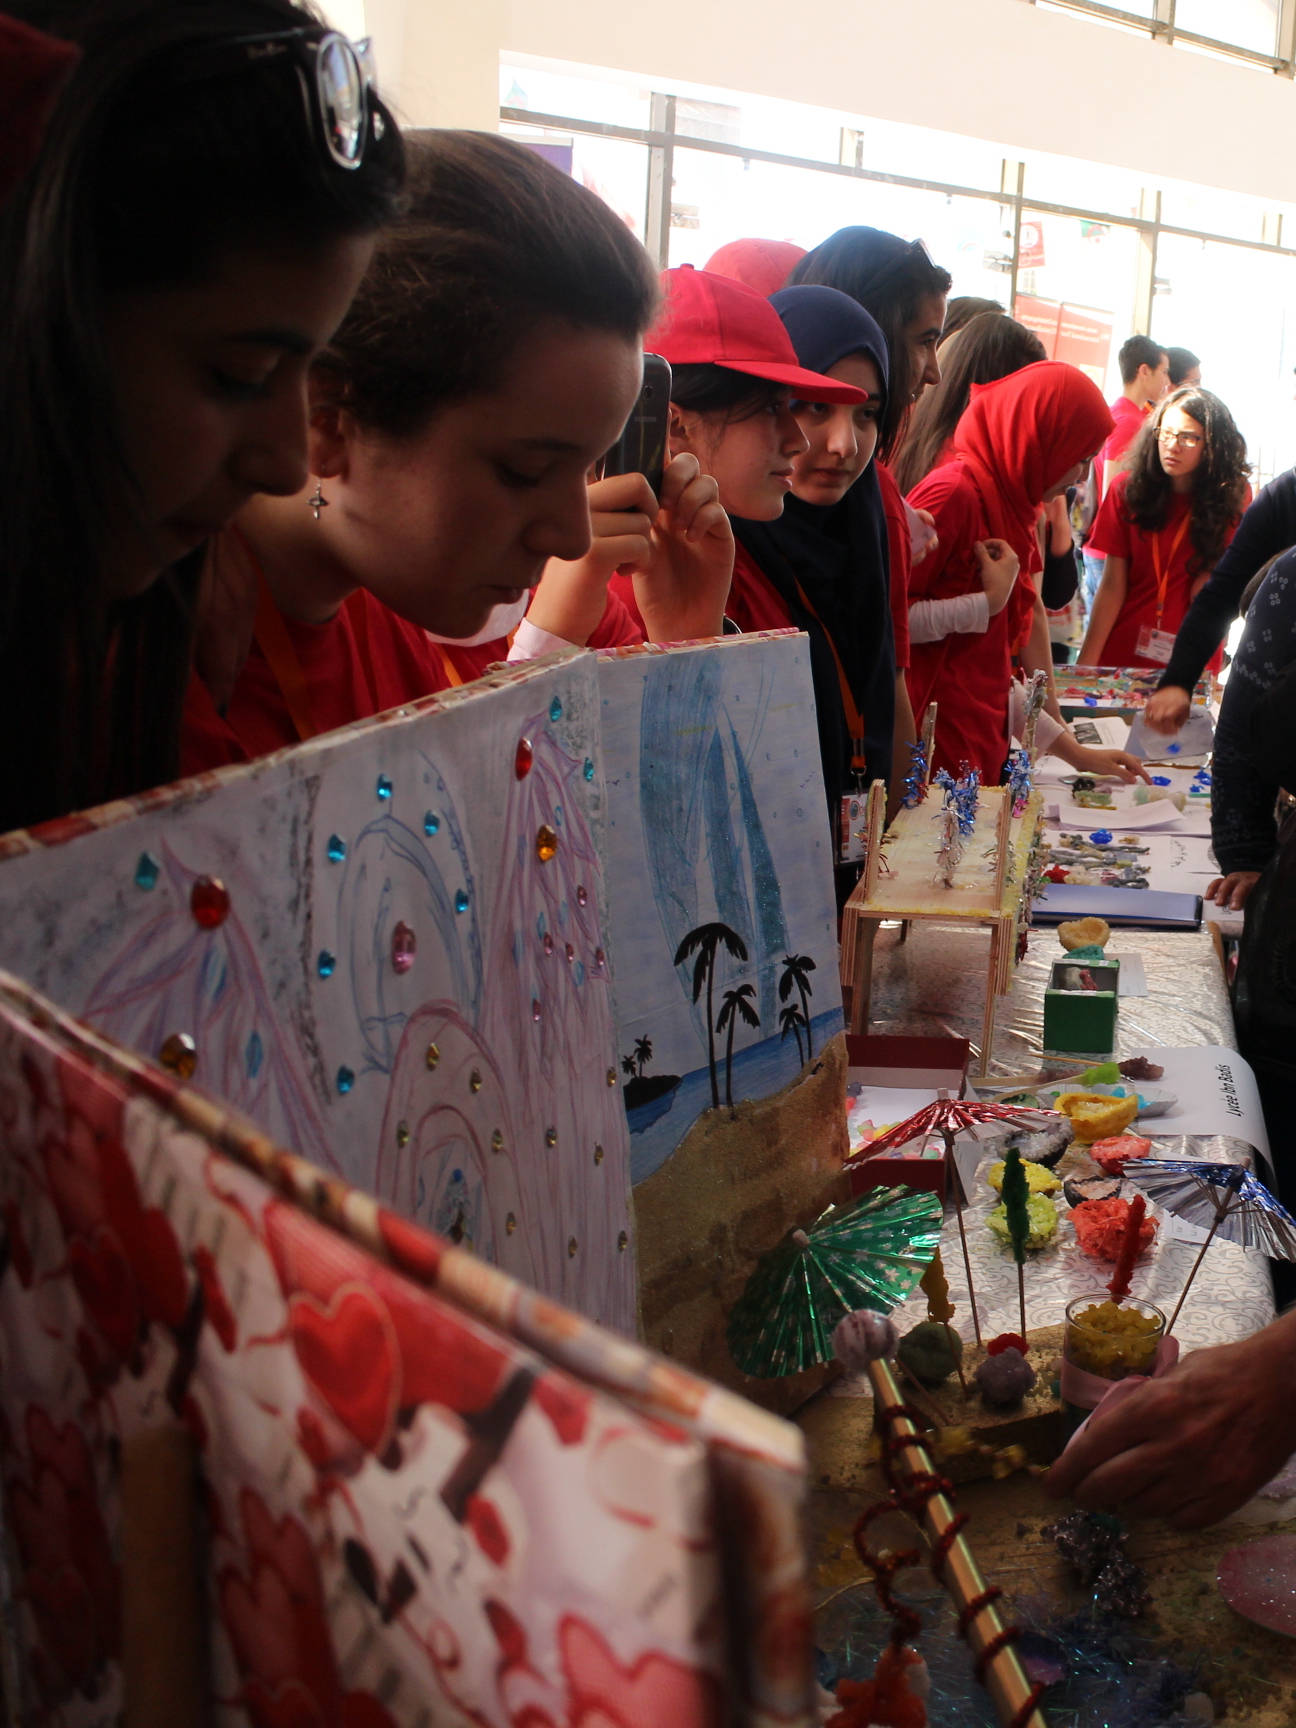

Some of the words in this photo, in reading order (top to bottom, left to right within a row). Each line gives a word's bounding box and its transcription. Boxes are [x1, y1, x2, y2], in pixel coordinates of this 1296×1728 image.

[1215, 1064, 1233, 1083] Badis
[1219, 1083, 1236, 1095] Ibn
[1219, 1095, 1244, 1117] Lycée
